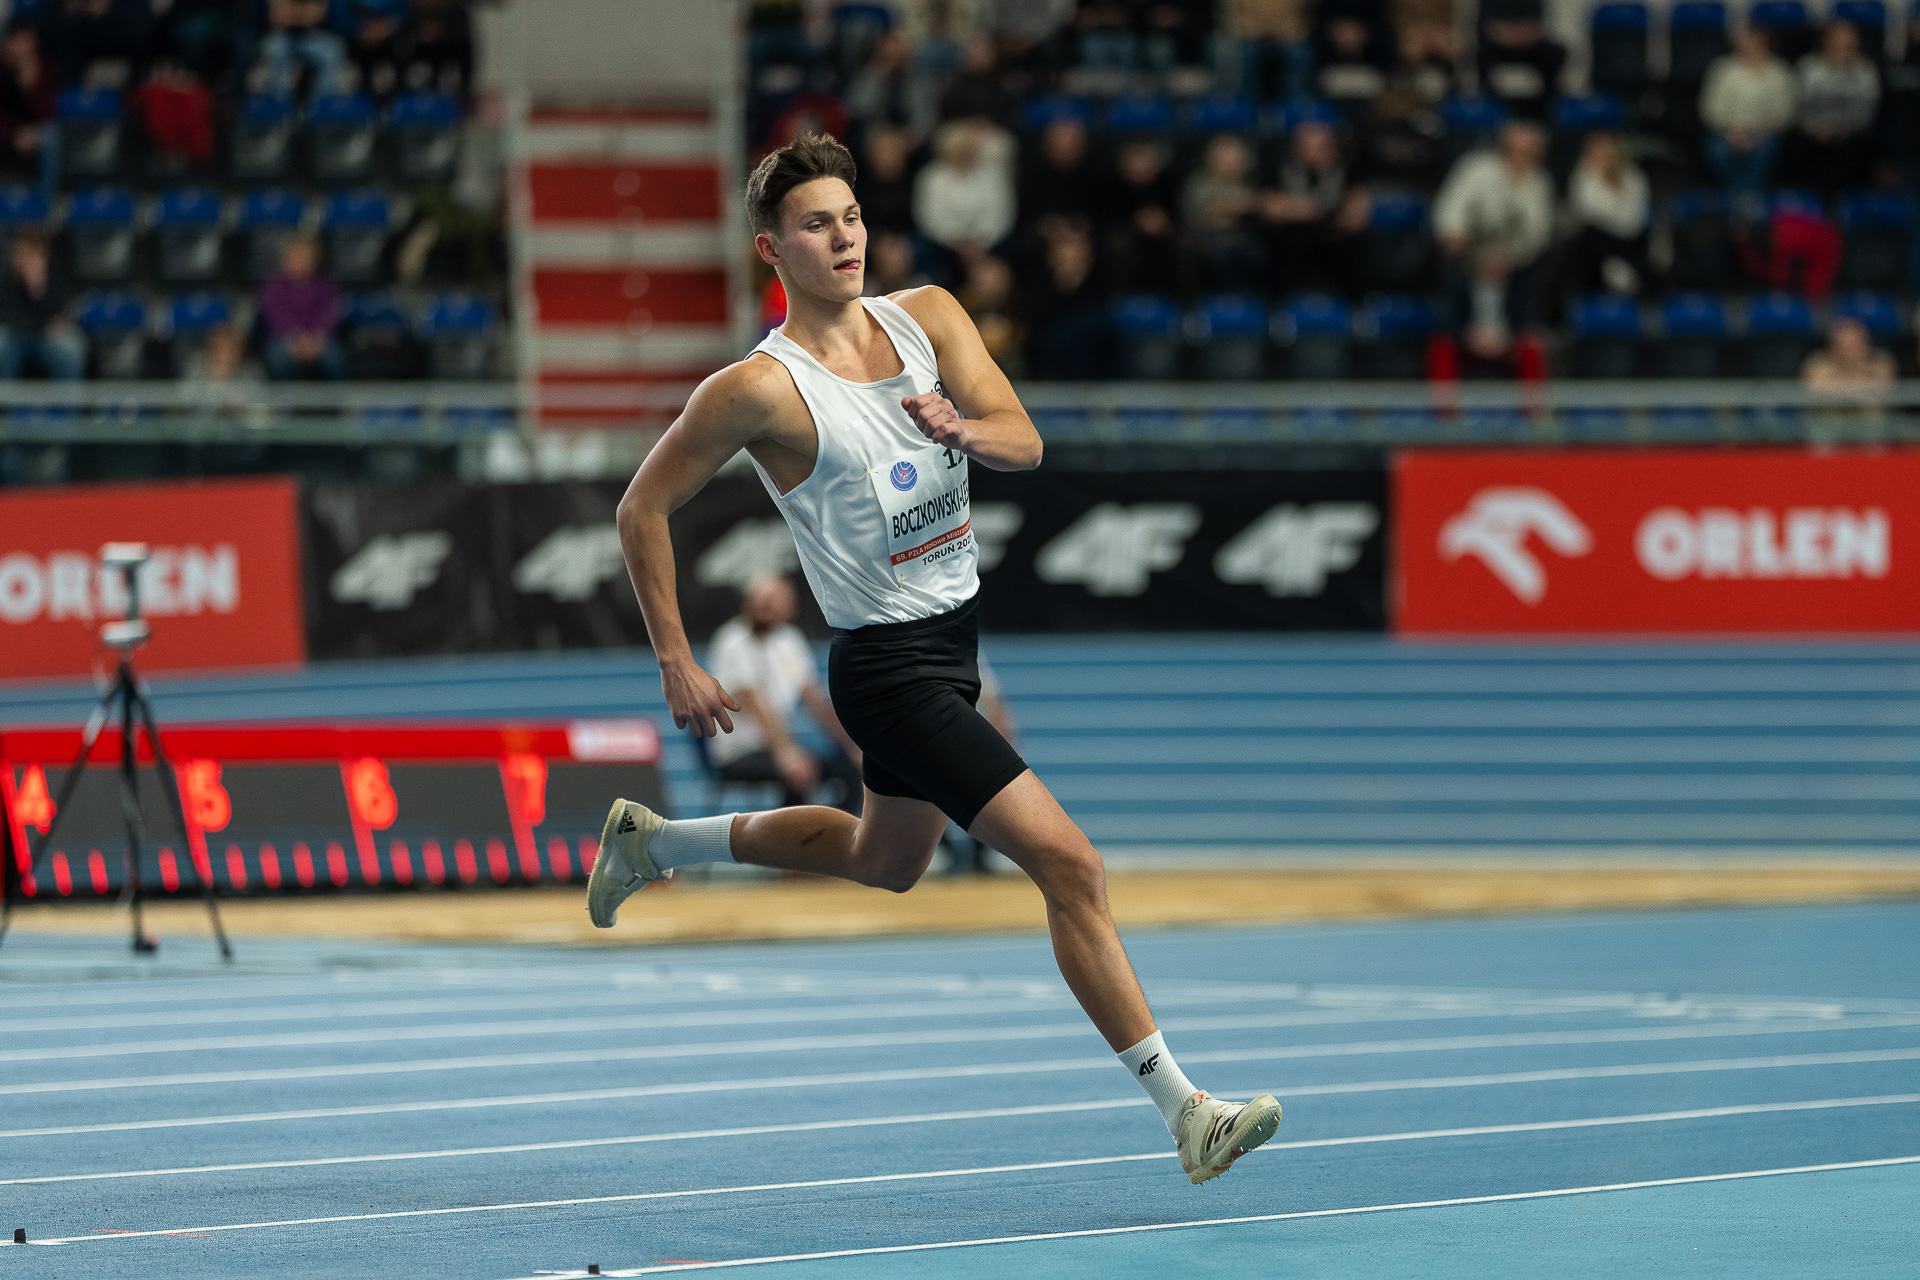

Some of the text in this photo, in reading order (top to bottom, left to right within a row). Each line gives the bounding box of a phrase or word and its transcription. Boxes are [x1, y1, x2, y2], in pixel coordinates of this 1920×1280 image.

[331, 530, 451, 608] 4F
[908, 547, 924, 558] PZLA
[924, 537, 946, 552] Halowe
[922, 533, 972, 566] TORUŃ 202
[1036, 503, 1202, 597] 4F
[1214, 503, 1380, 597] 4F
[1635, 506, 1890, 580] ORLEN
[0, 546, 239, 622] ORLEN
[14, 762, 56, 834] 4
[184, 757, 232, 833] 5
[350, 755, 398, 830] 6
[505, 752, 548, 827] 7
[1139, 1053, 1159, 1076] 4F
